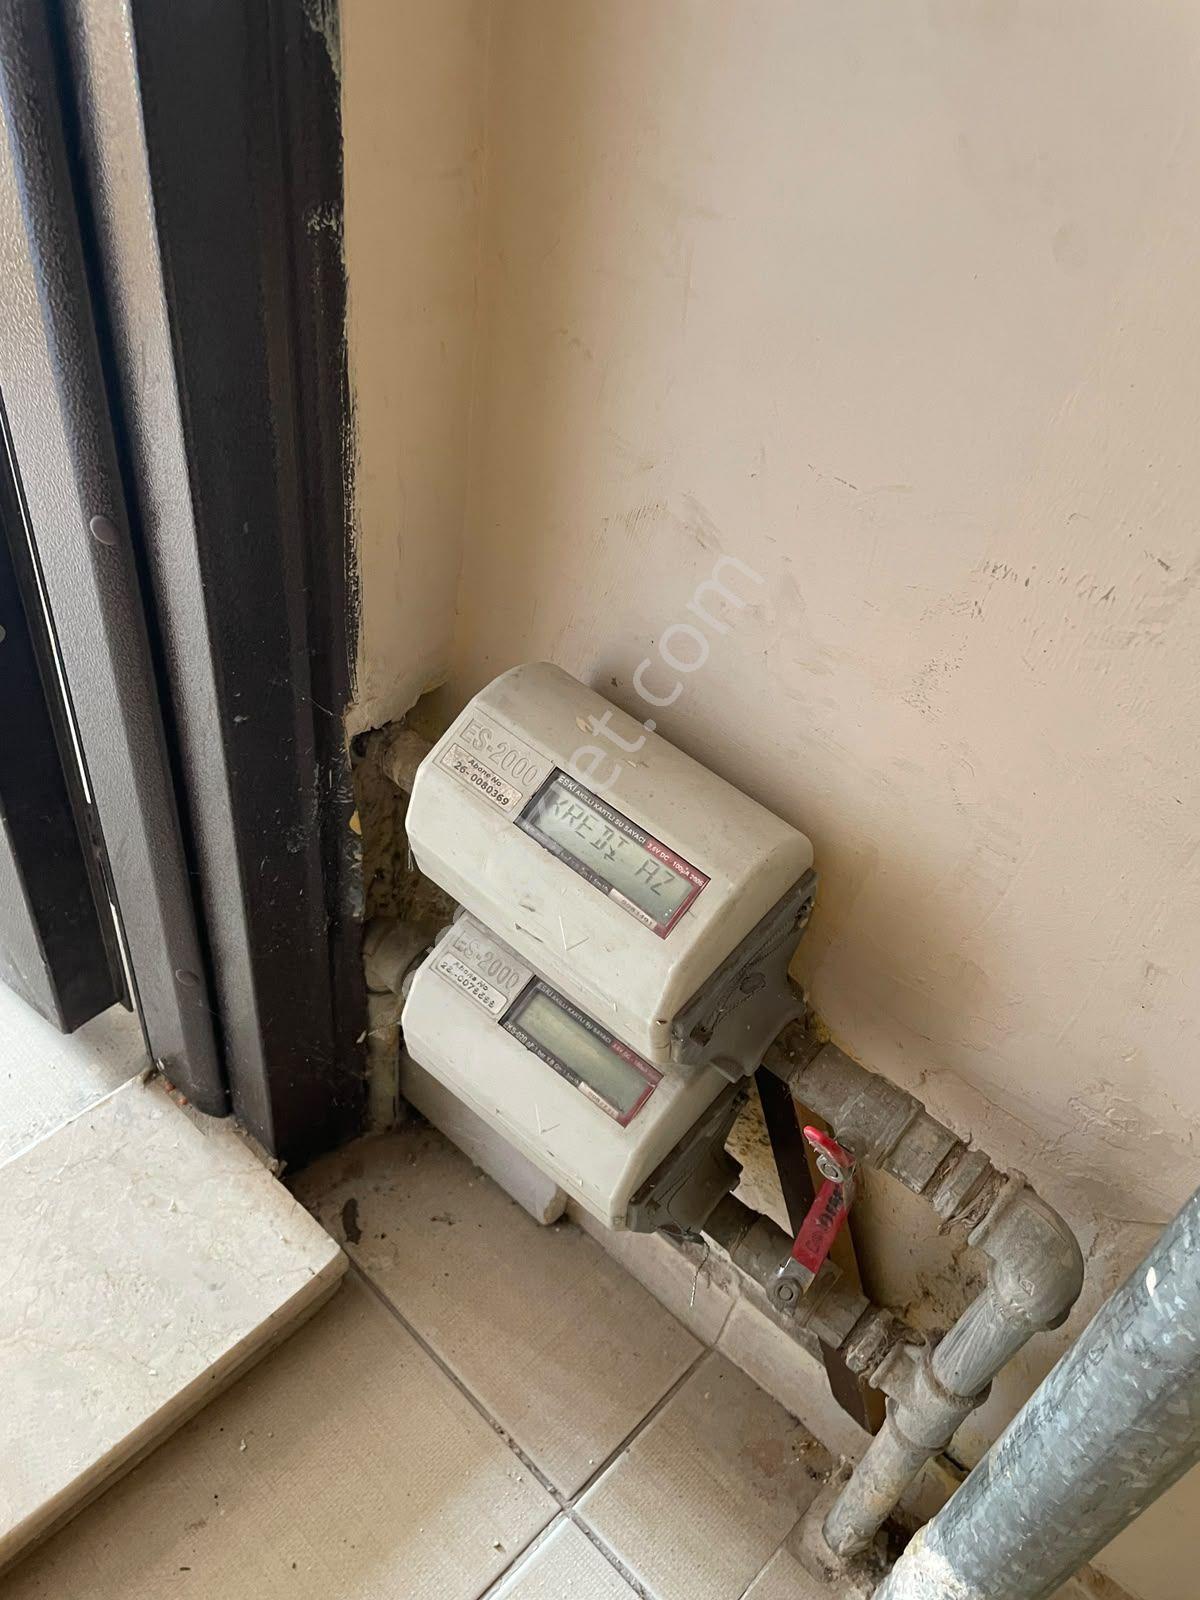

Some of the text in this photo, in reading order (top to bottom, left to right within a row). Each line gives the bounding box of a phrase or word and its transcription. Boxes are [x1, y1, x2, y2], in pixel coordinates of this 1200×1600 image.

[457, 716, 540, 788] ES-2000
[613, 818, 624, 828] SU
[658, 851, 670, 861] DC
[633, 857, 676, 896] AZ
